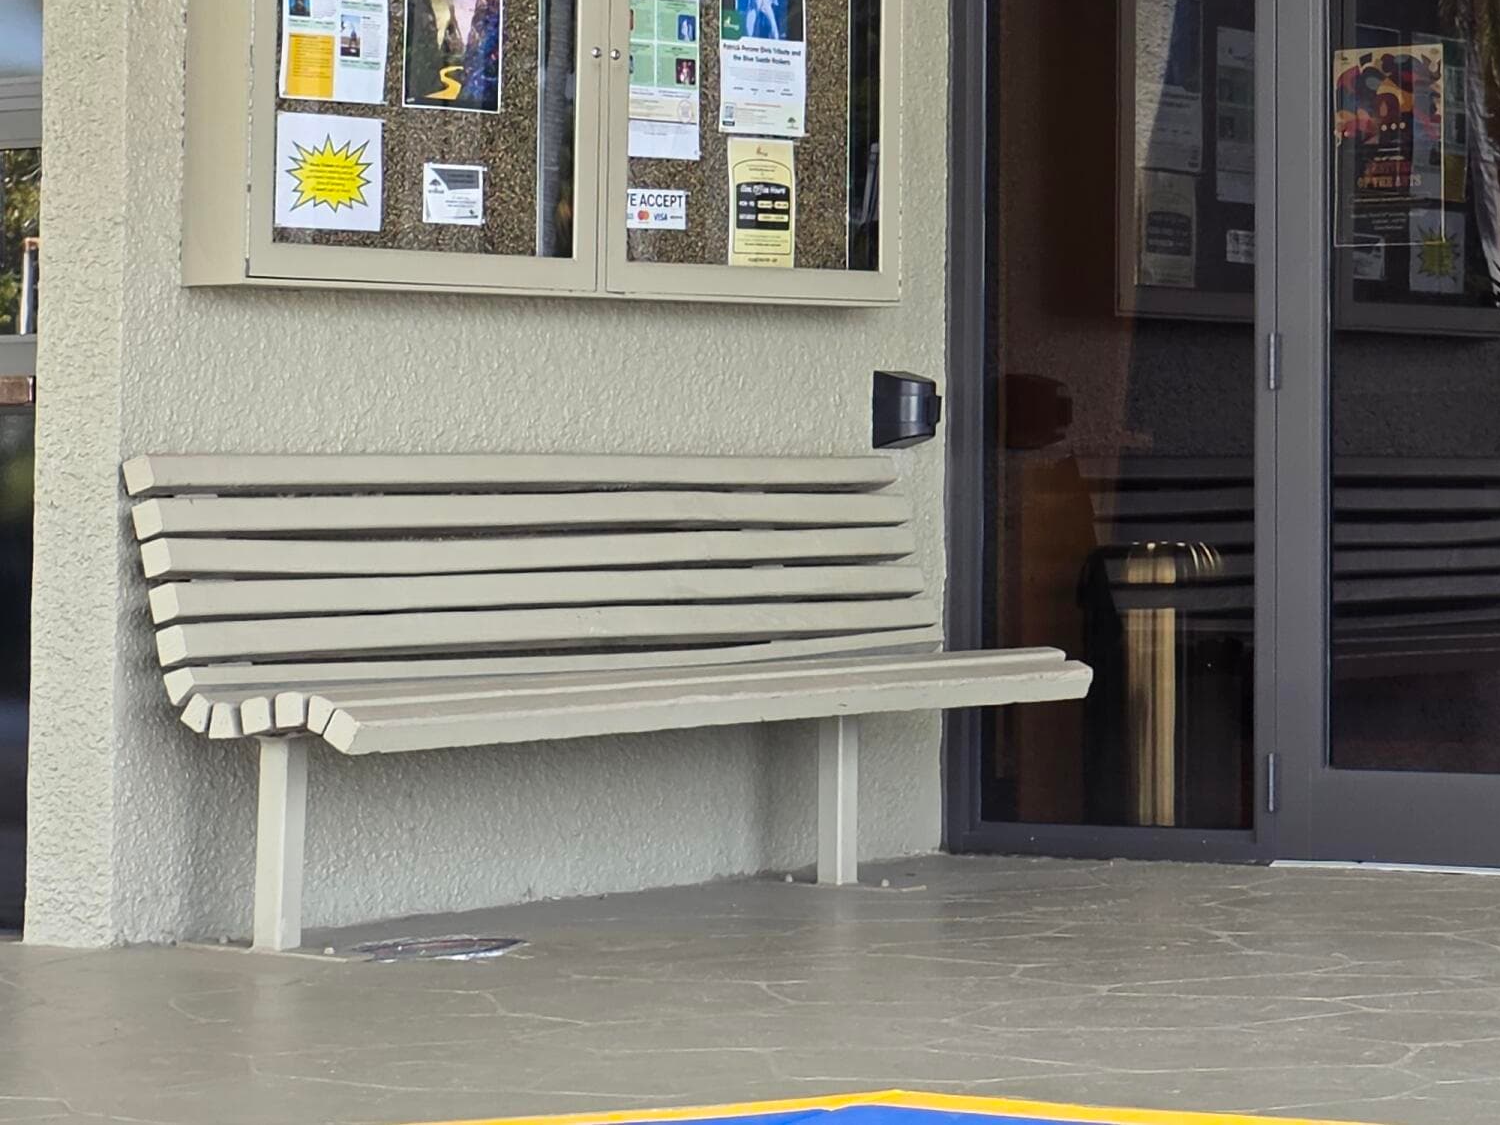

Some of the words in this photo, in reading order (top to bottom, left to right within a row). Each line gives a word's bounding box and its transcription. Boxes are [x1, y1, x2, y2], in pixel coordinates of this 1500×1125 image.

[627, 193, 637, 207] E
[640, 193, 683, 208] ACCEPT
[654, 213, 668, 221] VISA
